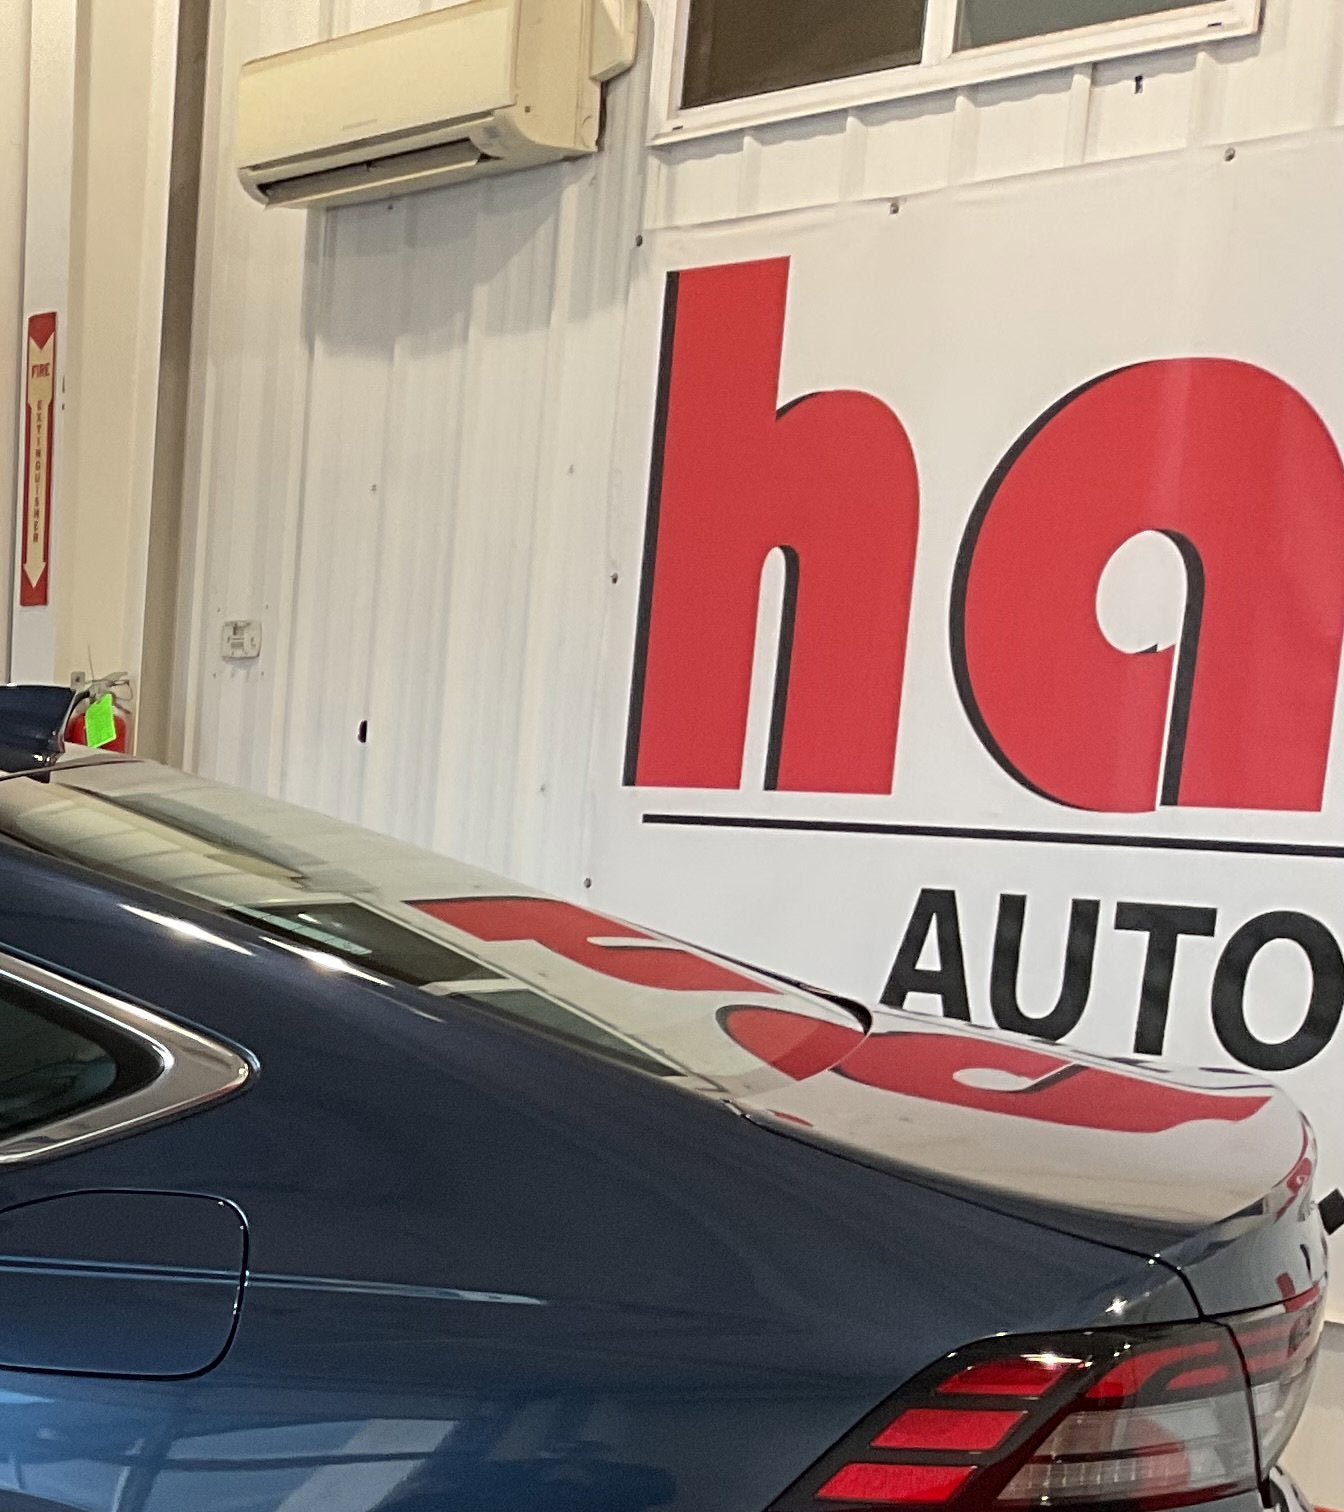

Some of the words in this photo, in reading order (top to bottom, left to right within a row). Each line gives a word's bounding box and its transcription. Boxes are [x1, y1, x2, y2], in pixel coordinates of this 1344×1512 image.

[31, 363, 50, 378] FIRE
[33, 399, 43, 543] EXTINGUISHER
[623, 255, 1344, 812] ha
[879, 888, 1344, 1072] AUTO
